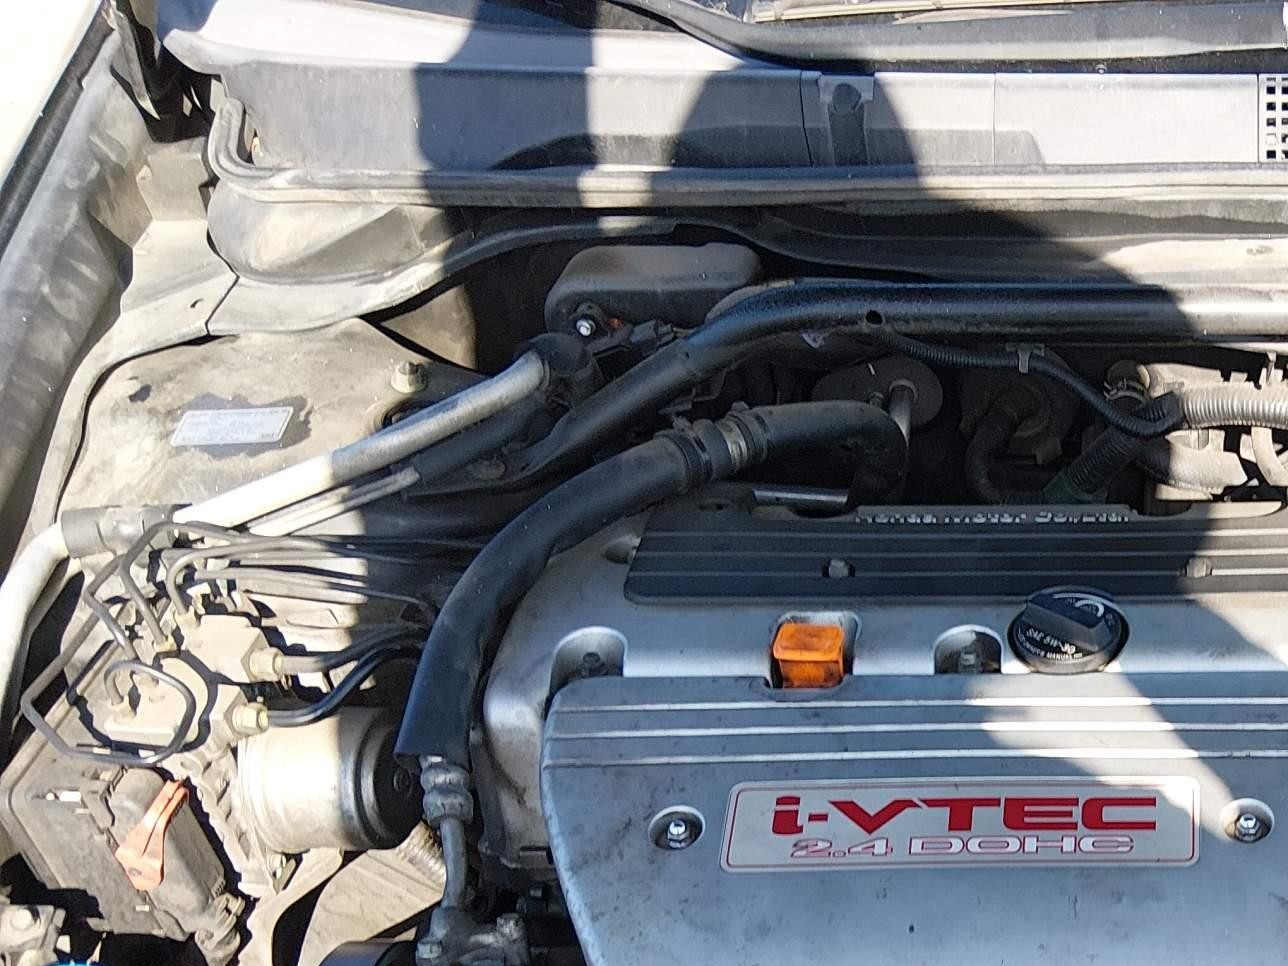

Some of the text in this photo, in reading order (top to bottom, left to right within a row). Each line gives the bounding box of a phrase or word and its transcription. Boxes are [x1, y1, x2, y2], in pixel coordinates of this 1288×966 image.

[771, 795, 1157, 835] i-VTEC
[790, 834, 1134, 859] 2.4 DOHC
